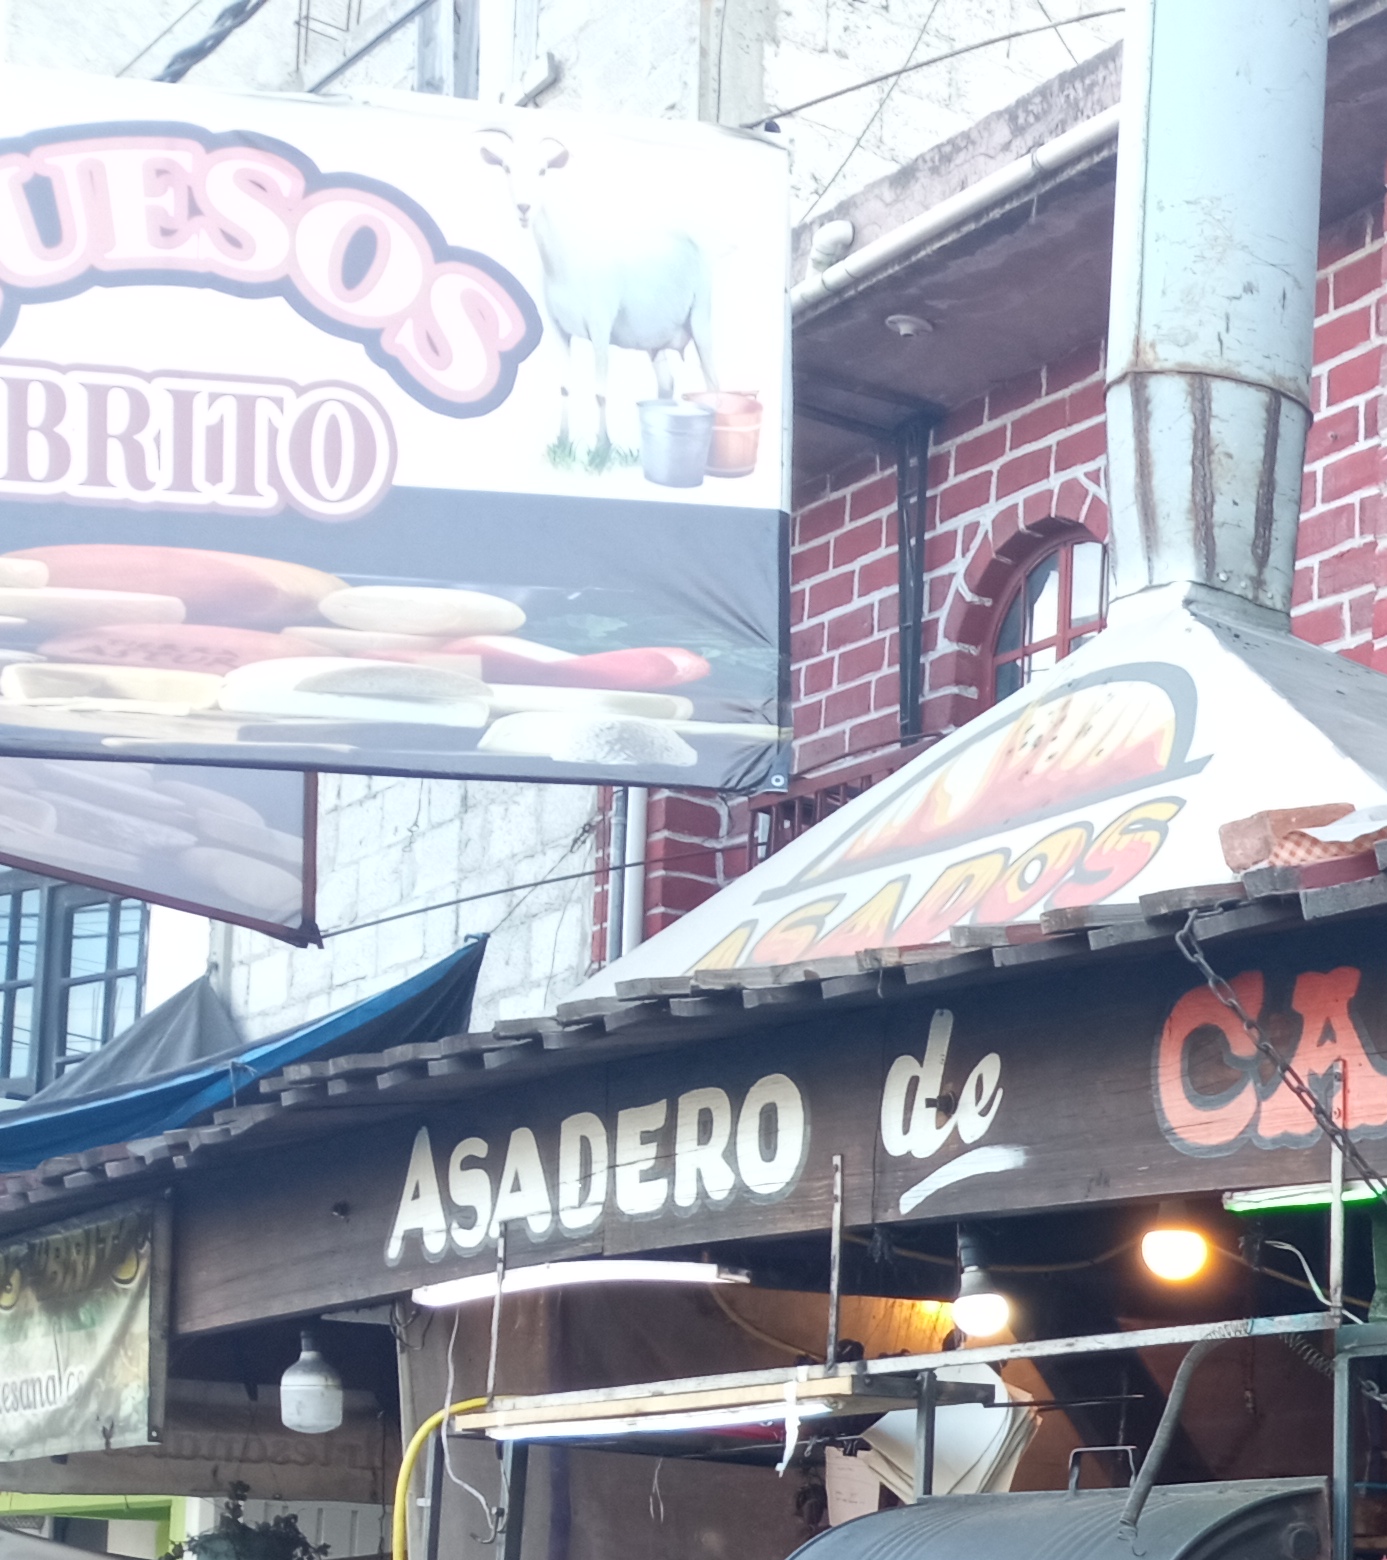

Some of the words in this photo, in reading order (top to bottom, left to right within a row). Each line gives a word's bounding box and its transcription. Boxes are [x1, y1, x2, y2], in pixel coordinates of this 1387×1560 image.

[0, 134, 527, 406] UESOS
[0, 376, 368, 504] BRITO
[387, 1073, 806, 1264] ASADERO
[880, 1009, 1003, 1160] de
